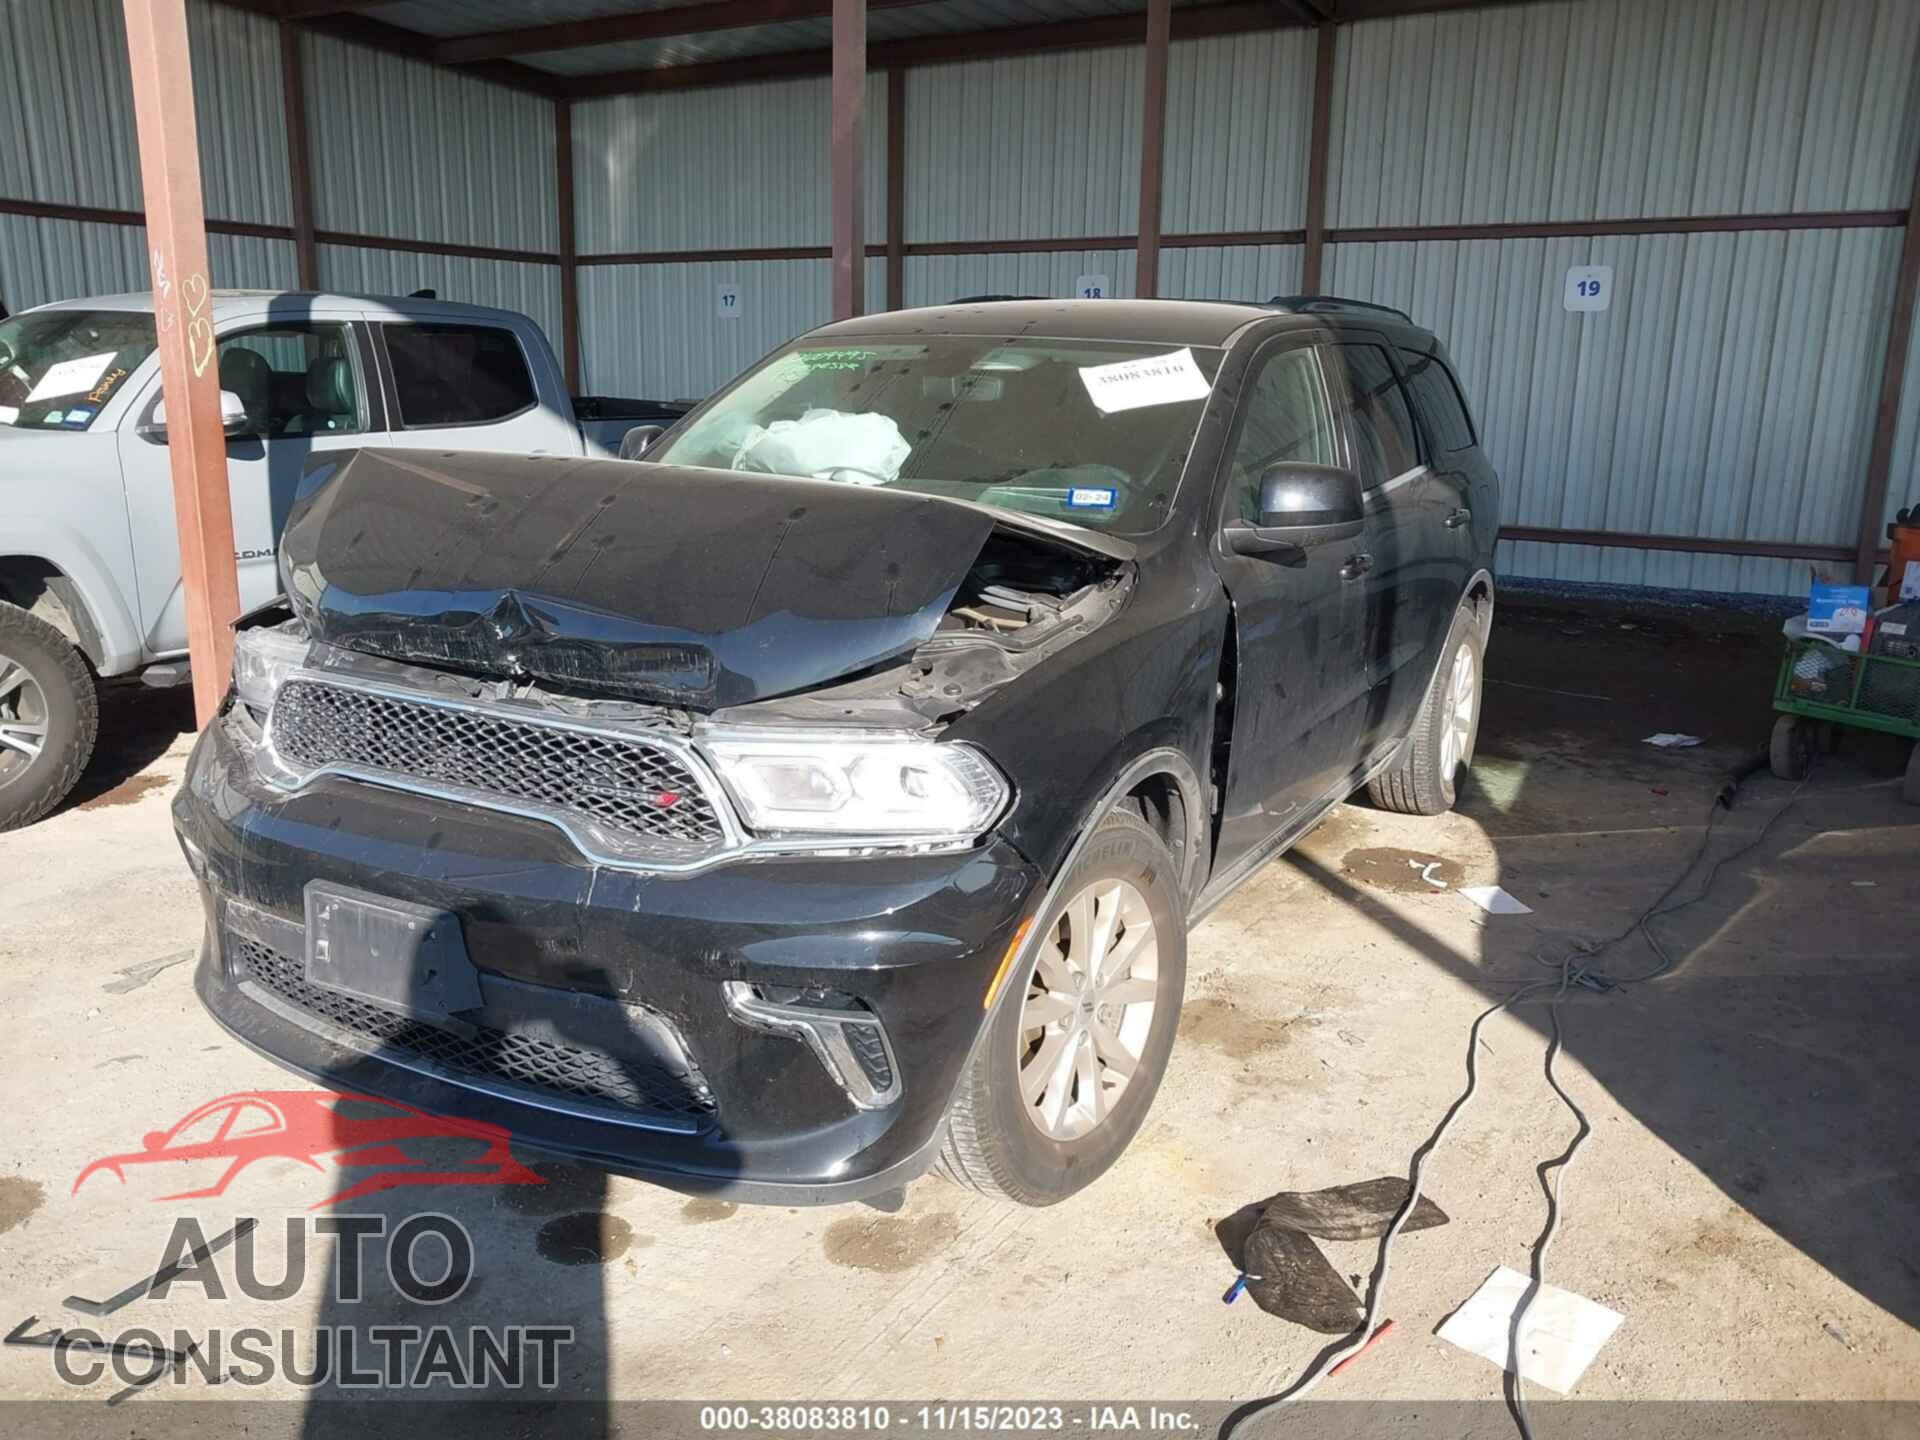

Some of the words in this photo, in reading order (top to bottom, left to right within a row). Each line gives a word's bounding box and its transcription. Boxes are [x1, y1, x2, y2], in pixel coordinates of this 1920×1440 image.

[1084, 287, 1102, 299] 18
[1577, 280, 1601, 297] 19
[721, 294, 736, 306] 17
